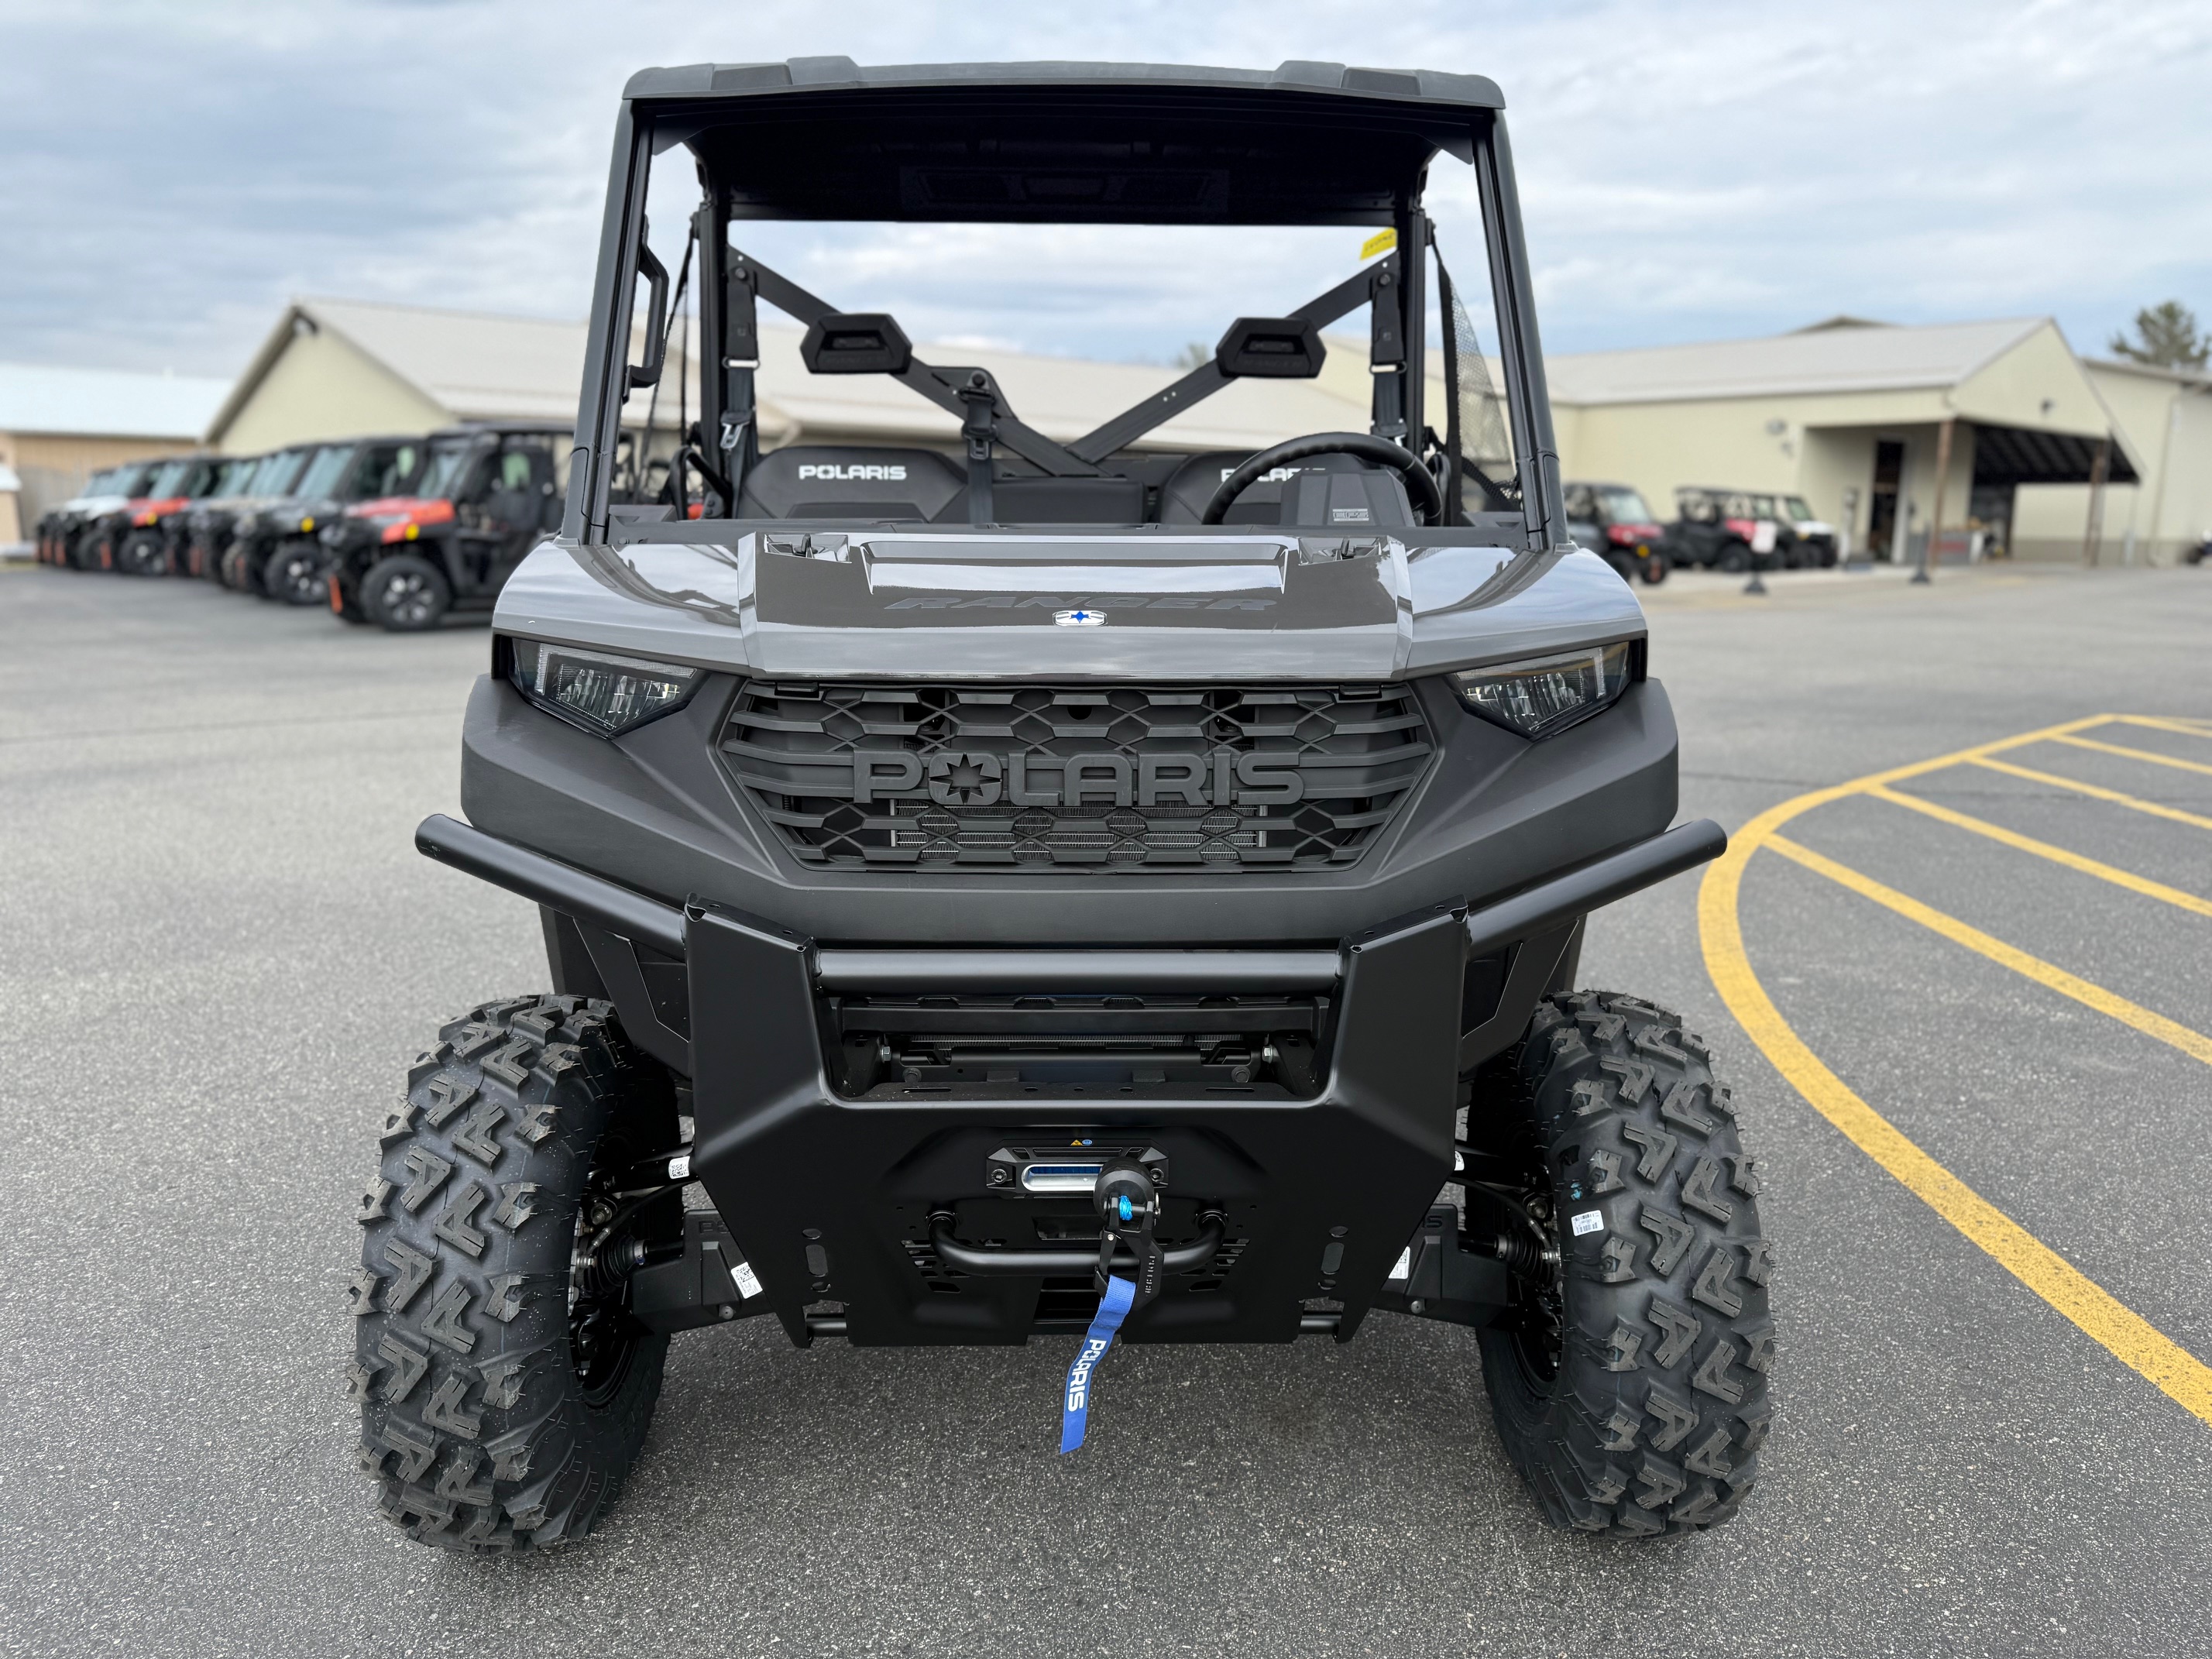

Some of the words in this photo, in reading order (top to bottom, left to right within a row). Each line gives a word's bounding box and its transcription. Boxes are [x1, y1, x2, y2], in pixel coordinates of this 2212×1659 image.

[799, 465, 907, 480] POLARIS
[884, 596, 1277, 611] RANGER
[854, 748, 1305, 806] POLARIS
[1068, 1339, 1108, 1412] POLARIS
